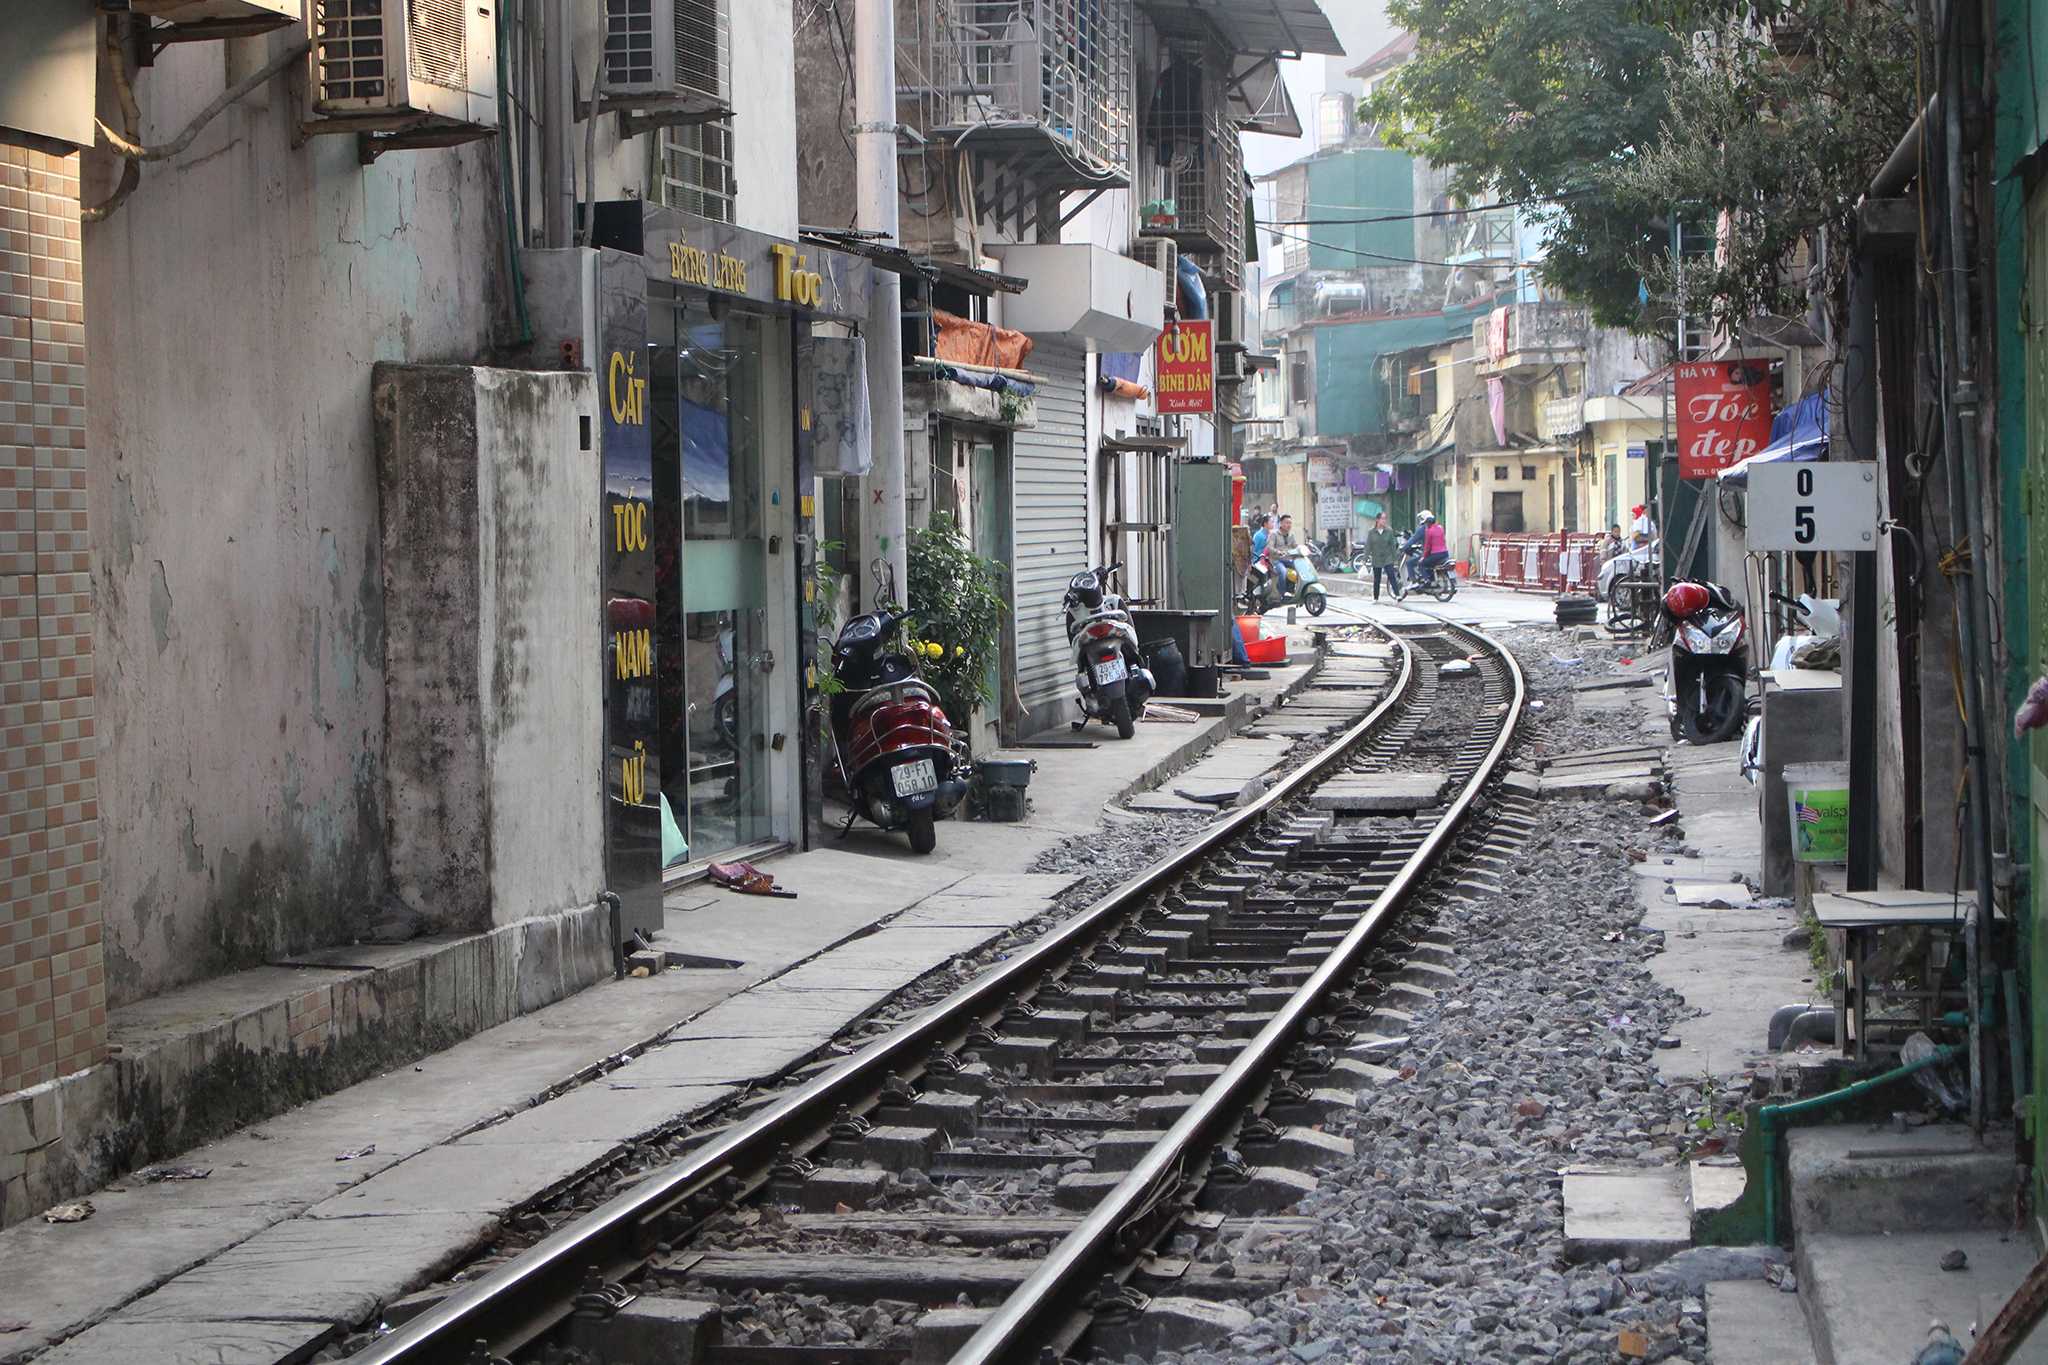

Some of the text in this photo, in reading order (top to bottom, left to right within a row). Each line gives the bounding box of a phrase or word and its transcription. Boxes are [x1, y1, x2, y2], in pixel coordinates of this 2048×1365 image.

[1161, 327, 1208, 363] CƠM
[1187, 368, 1211, 392] DÂN
[1688, 393, 1760, 424] Tóc
[1690, 428, 1758, 466] đẹp
[613, 486, 648, 552] TÓC
[1795, 505, 1816, 544] 5
[616, 628, 653, 681] NAM
